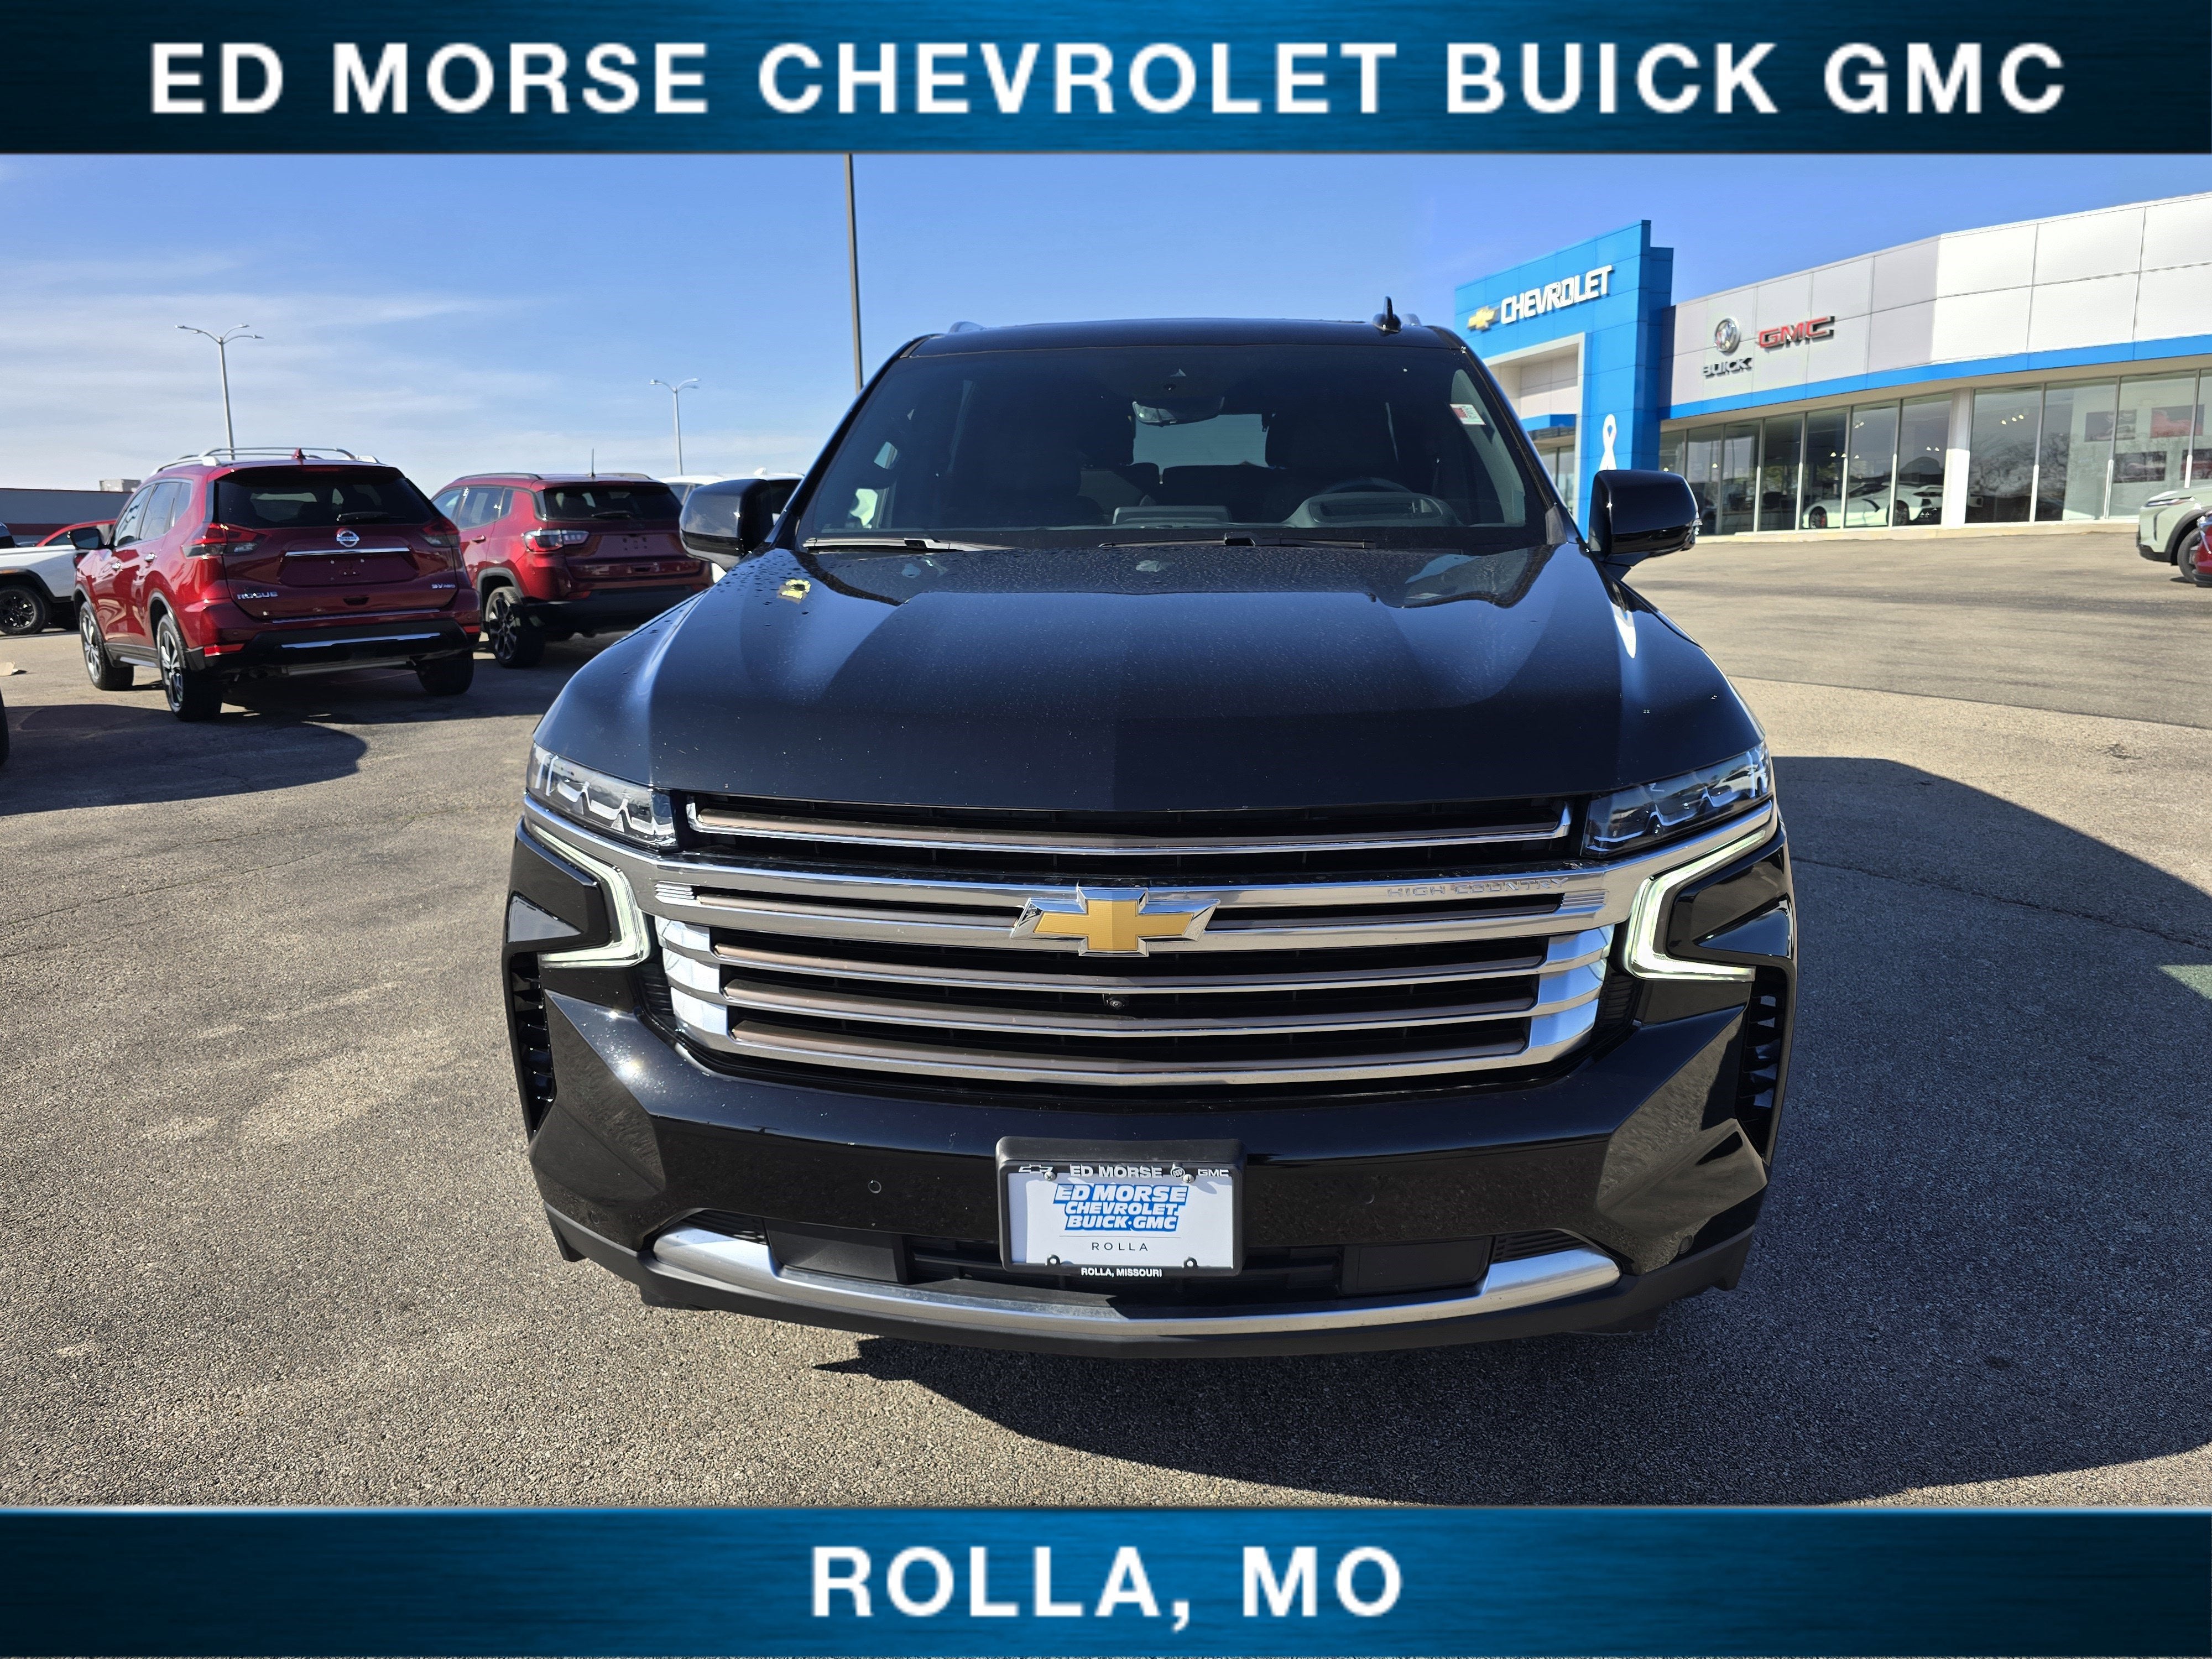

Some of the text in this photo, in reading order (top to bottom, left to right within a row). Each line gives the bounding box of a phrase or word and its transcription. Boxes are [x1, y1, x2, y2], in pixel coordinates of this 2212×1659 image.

[1500, 265, 1614, 325] CHEVROLET
[1759, 316, 1835, 348] GMC
[1702, 357, 1752, 378] BUICK
[237, 591, 278, 599] ROGUE
[1387, 877, 1569, 898] HIGH COUNTRY
[1070, 1165, 1229, 1178] ED MORSE GMC
[1055, 1185, 1188, 1202] ED MORSE
[1091, 1242, 1149, 1251] ROLLA
[1081, 1267, 1162, 1277] ROLLA, MISSOURI
